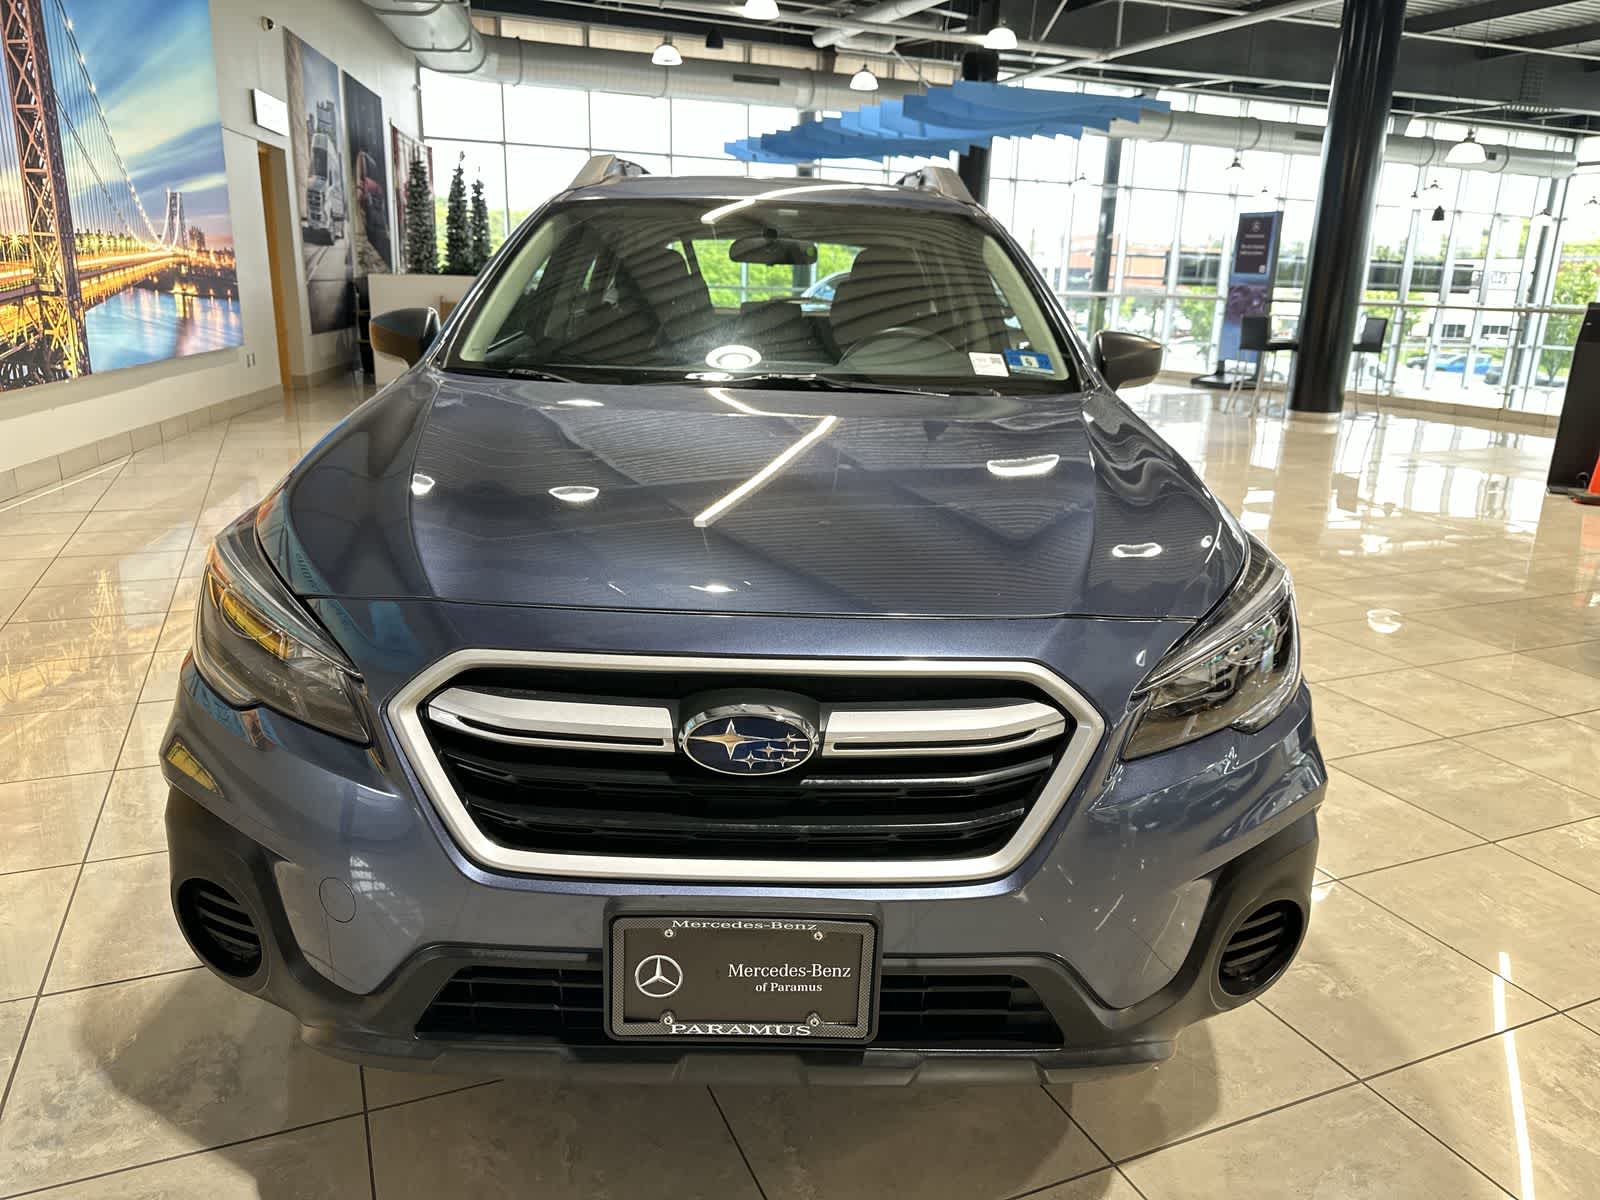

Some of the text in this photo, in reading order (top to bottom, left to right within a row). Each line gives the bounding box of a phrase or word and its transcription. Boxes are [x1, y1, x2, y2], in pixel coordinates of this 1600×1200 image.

[671, 919, 818, 931] Mercedes-Benz
[728, 963, 851, 978] Mercedes-Benz
[755, 982, 823, 992] of Paramus
[670, 1024, 812, 1036] PARAMUS
